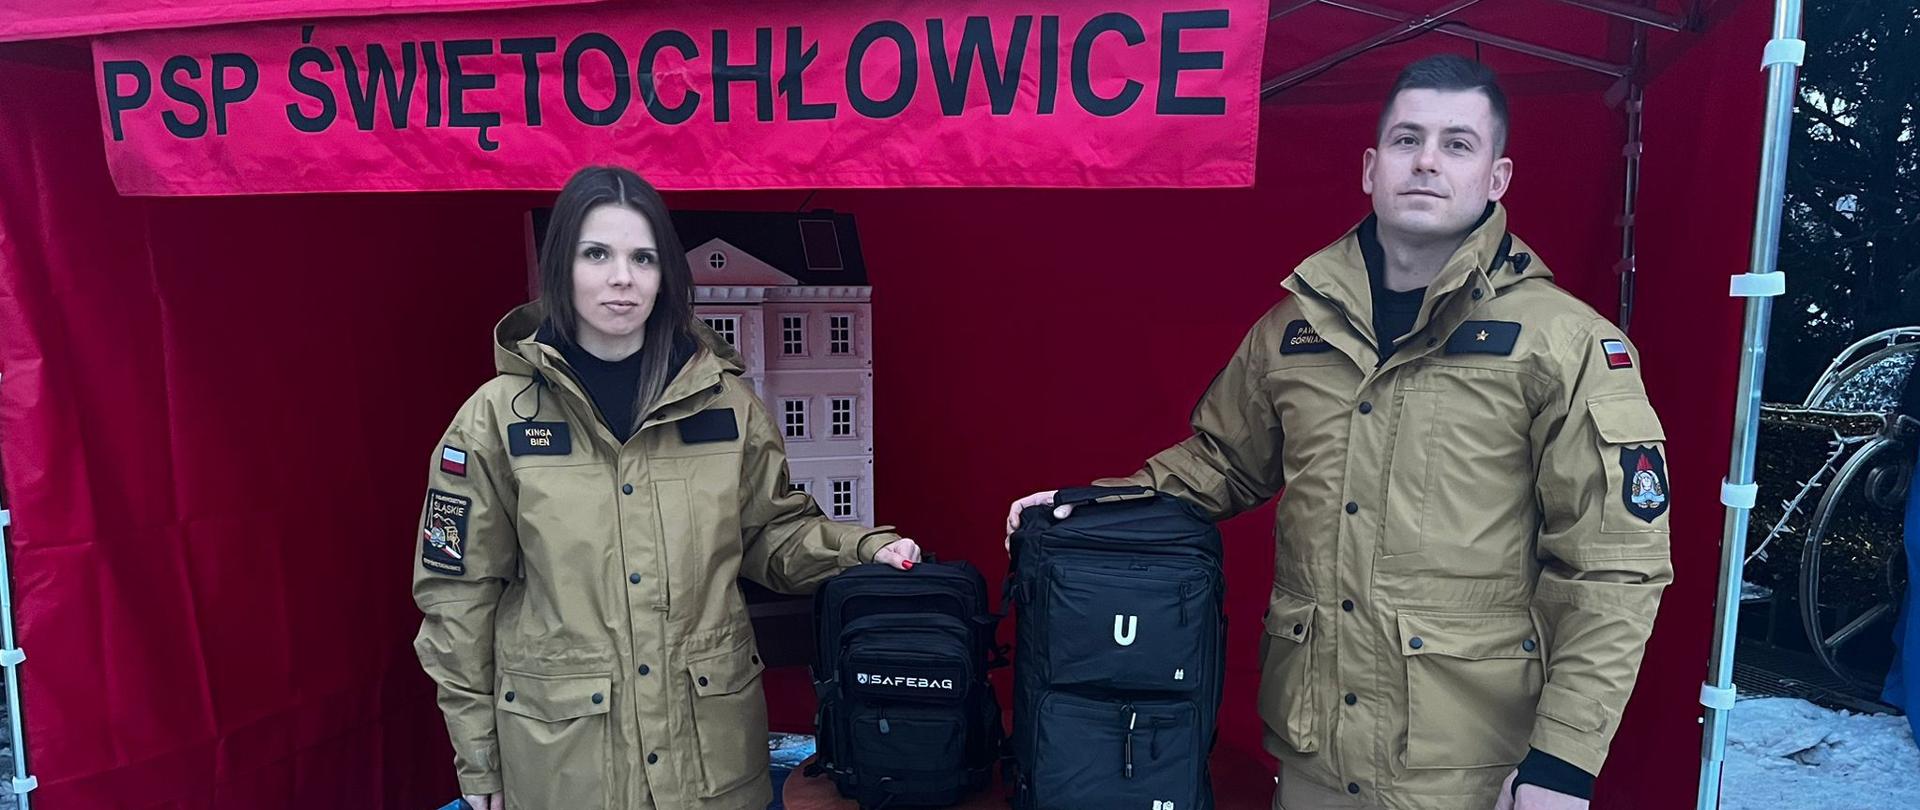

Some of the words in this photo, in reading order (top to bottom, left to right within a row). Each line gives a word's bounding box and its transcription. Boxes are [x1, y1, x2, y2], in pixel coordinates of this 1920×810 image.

[103, 54, 259, 142] PSP
[286, 9, 1230, 151] ŚWIĘTOCHŁOWICE
[525, 428, 552, 437] KINGA
[1114, 614, 1138, 646] U
[871, 674, 953, 690] SAFEBAG
